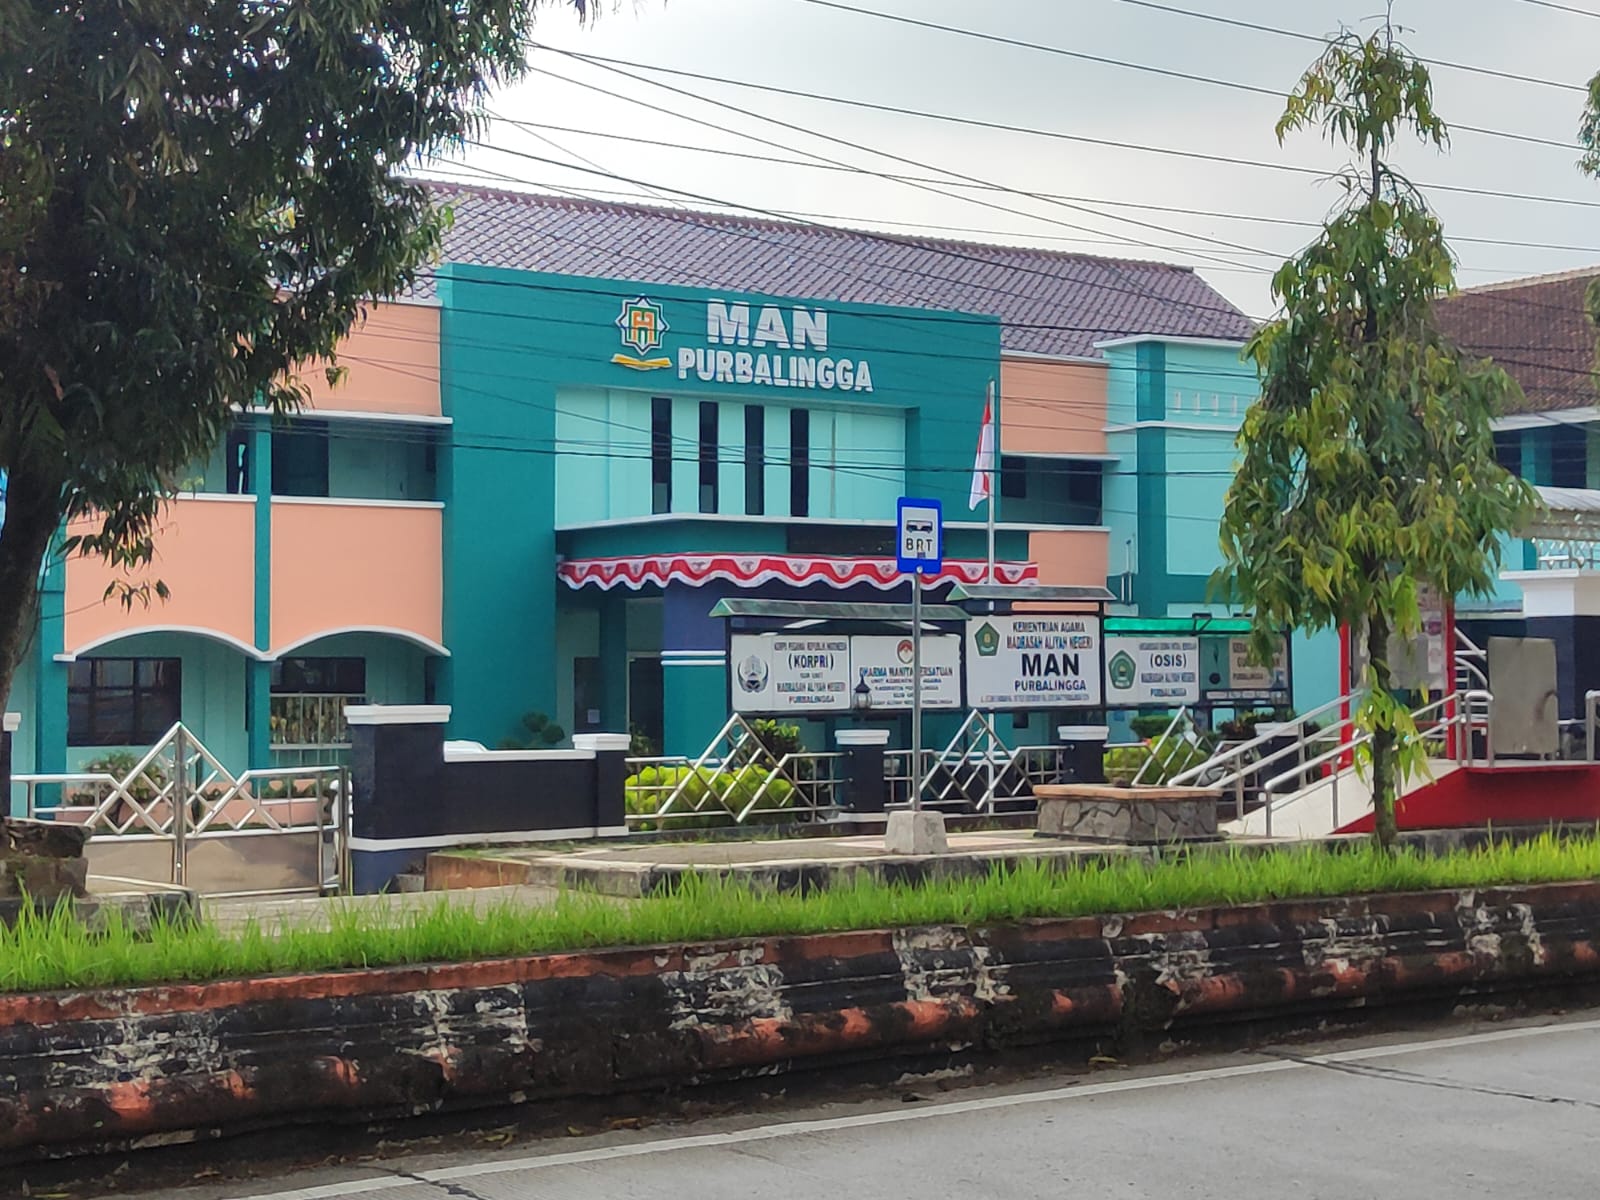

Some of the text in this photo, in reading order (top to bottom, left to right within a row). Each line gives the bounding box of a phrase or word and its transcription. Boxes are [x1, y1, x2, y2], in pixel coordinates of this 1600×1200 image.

[706, 298, 829, 352] MAN
[677, 347, 874, 392] PURBALINGGA
[906, 538, 933, 552] BRT
[1061, 622, 1085, 633] AGAMA
[1021, 653, 1080, 677] MAN
[1150, 653, 1187, 668] (OSIS)
[1014, 680, 1087, 692] PURBALINGGA
